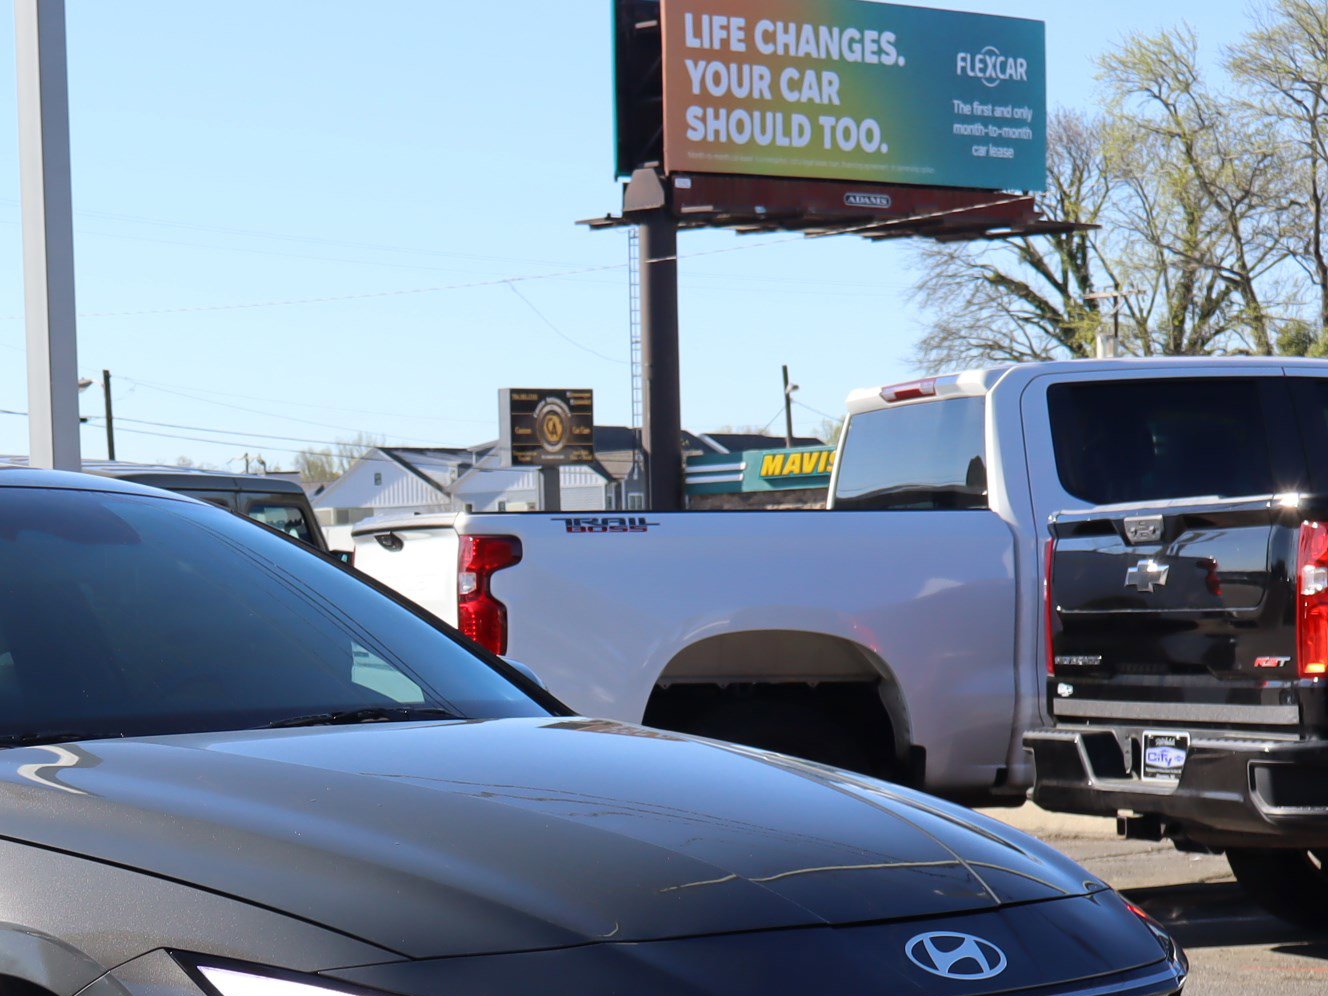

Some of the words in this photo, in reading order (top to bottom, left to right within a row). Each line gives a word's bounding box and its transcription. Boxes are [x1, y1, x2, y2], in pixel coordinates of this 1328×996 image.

[684, 12, 746, 52] LIFE
[754, 19, 906, 67] CHANGES.
[956, 50, 1027, 82] FLEXCAR
[684, 59, 772, 100] YOUR
[780, 67, 841, 106] CAR
[953, 99, 972, 115] The
[973, 101, 992, 117] first
[994, 105, 1012, 118] and
[1013, 106, 1033, 123] only
[686, 105, 812, 148] SHOULD
[819, 115, 889, 154] TOO.
[953, 123, 1033, 140] month-to-month
[972, 145, 988, 157] car
[989, 143, 1014, 158] lease
[847, 195, 888, 207] ADAMS
